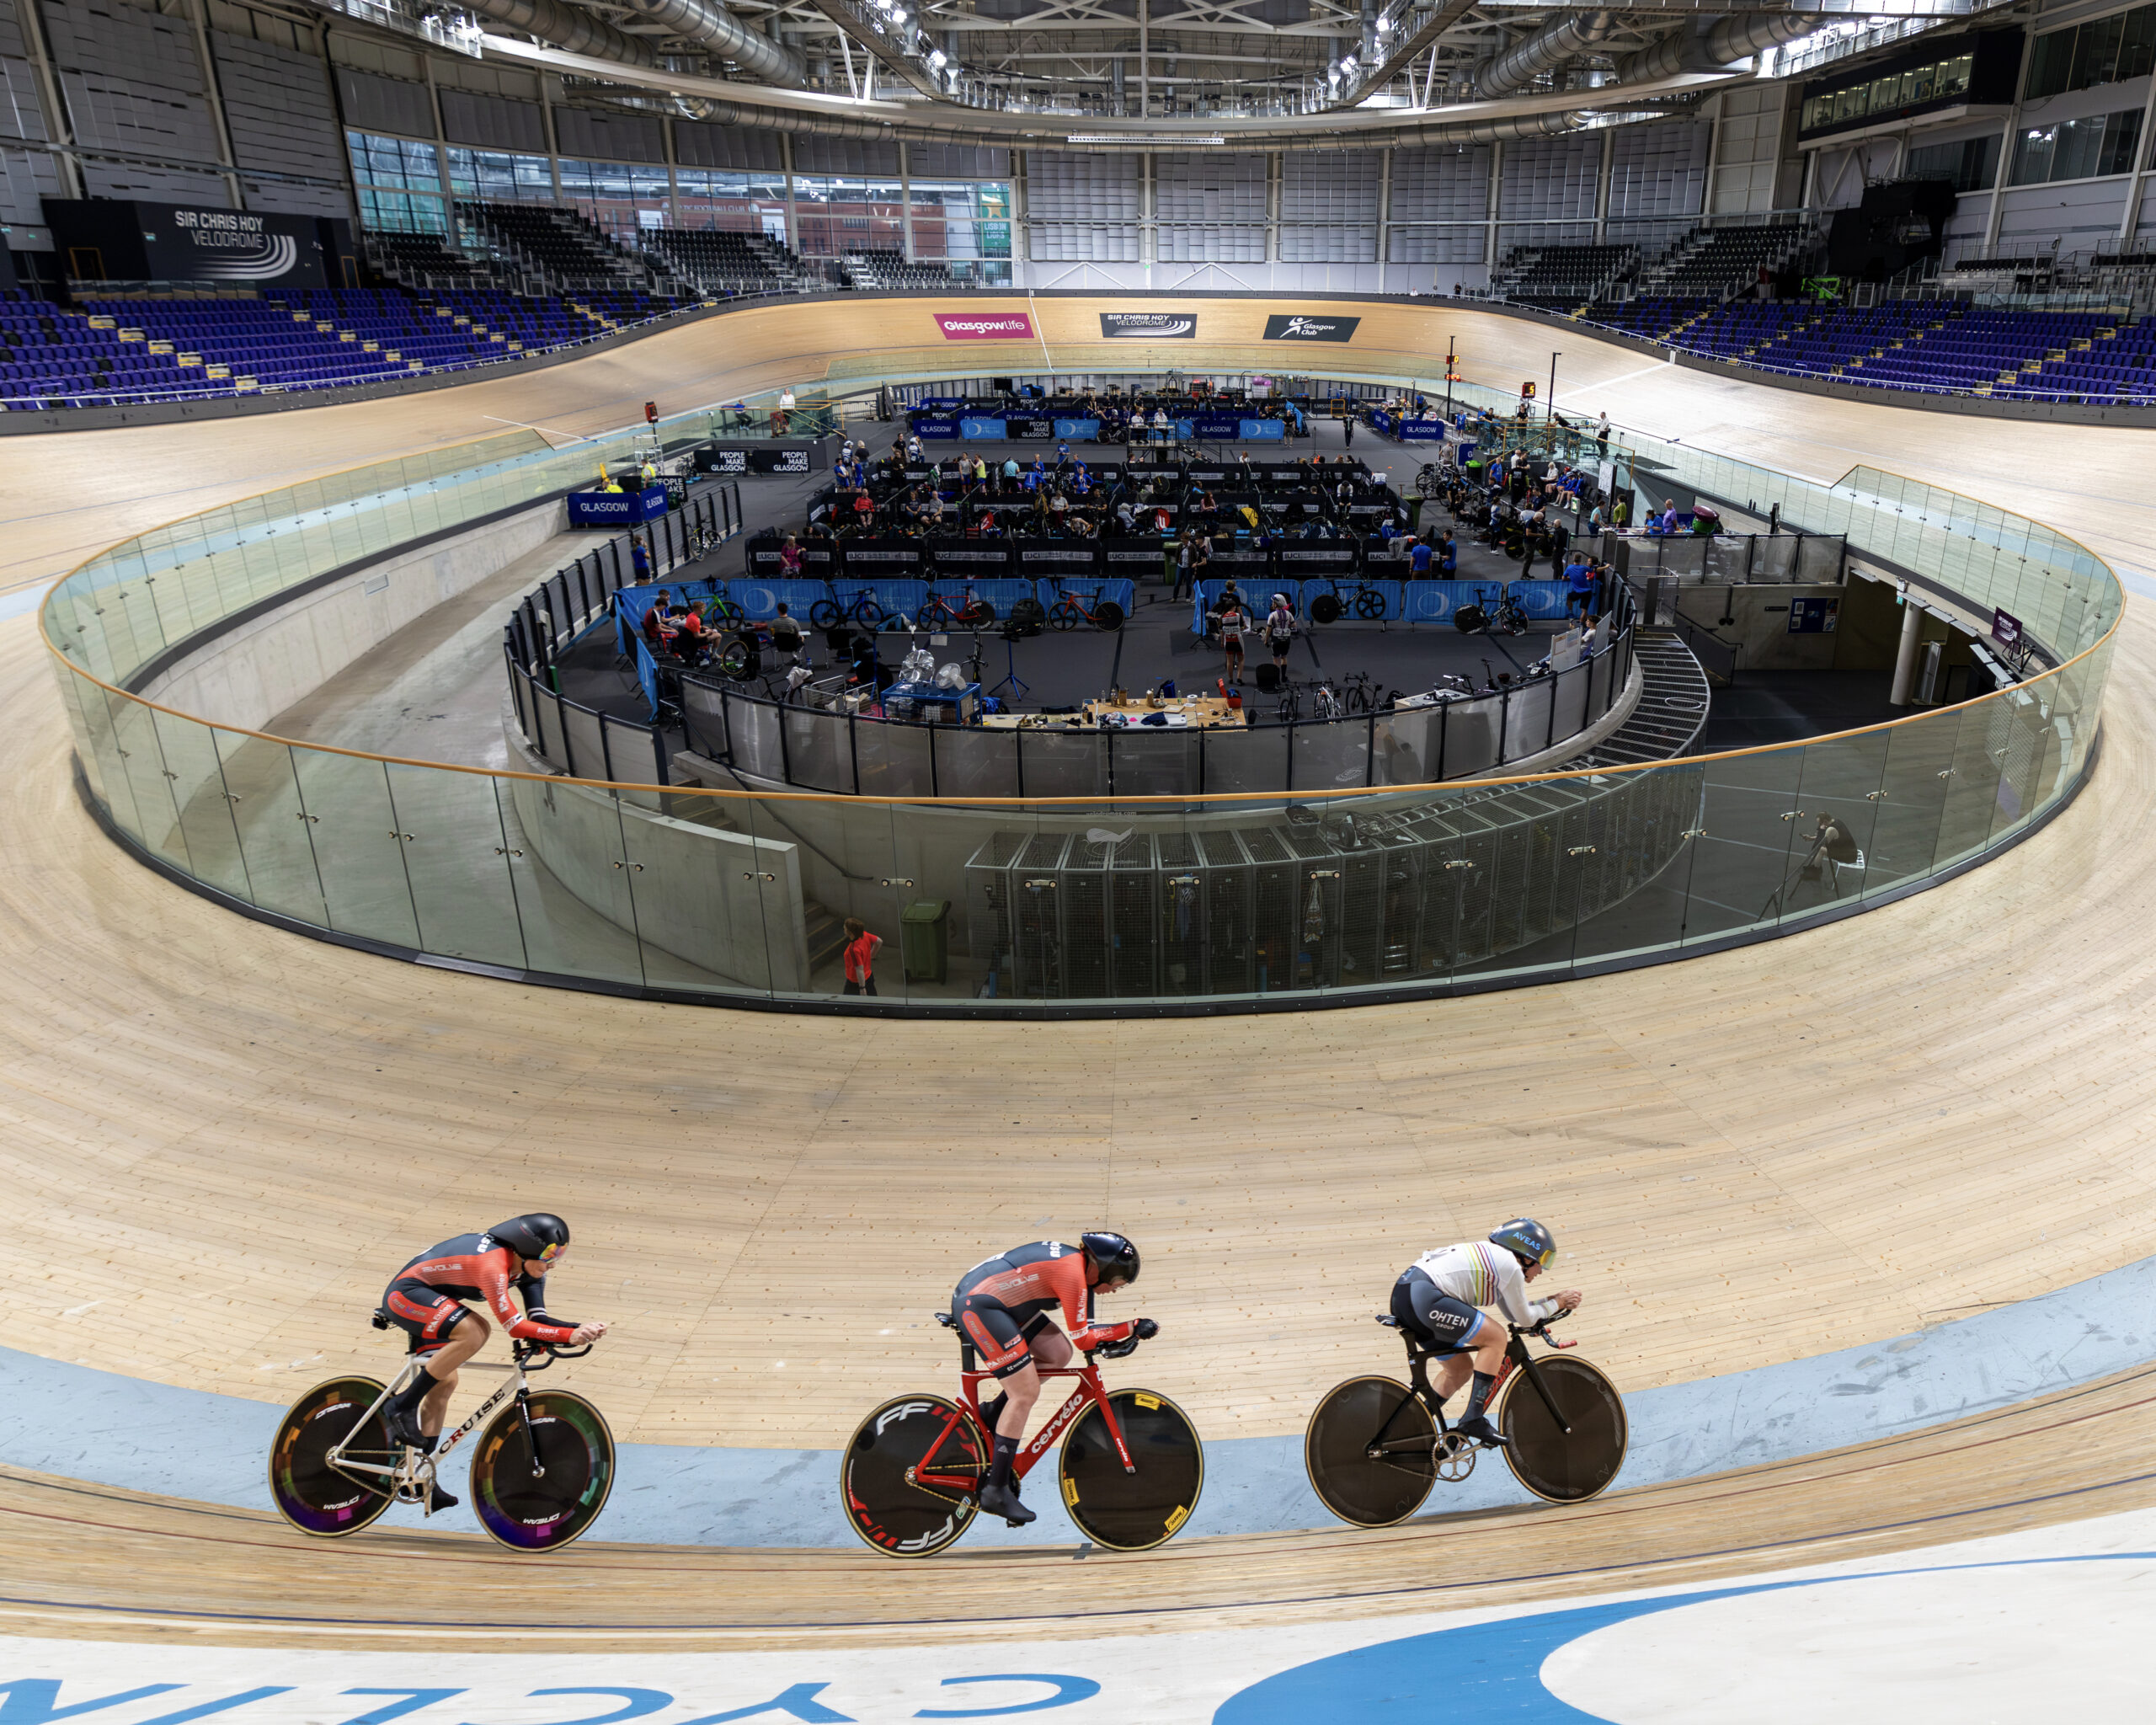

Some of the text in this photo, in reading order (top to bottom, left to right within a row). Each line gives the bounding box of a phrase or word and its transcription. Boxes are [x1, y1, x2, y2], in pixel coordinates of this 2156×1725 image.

[175, 211, 264, 232] SIR CHRIS HOY
[190, 229, 264, 249] VELODROME
[1529, 385, 1534, 394] 5
[580, 502, 629, 512] GLASGOW
[645, 494, 664, 509] GLASGOW
[1513, 1231, 1541, 1251] AVEAS
[998, 1274, 1040, 1291] EVOLVE
[1428, 1310, 1470, 1328] OHTEN
[1435, 1322, 1455, 1331] GROUP
[536, 1327, 560, 1335] BUBBLE
[439, 1389, 505, 1455] CRUISE
[1031, 1394, 1083, 1454] cervélo
[1116, 1437, 1129, 1462] cervélo
[323, 1494, 360, 1510] DREAM
[522, 1513, 561, 1525] DREAM
[1170, 1512, 1182, 1526] MAVIC
